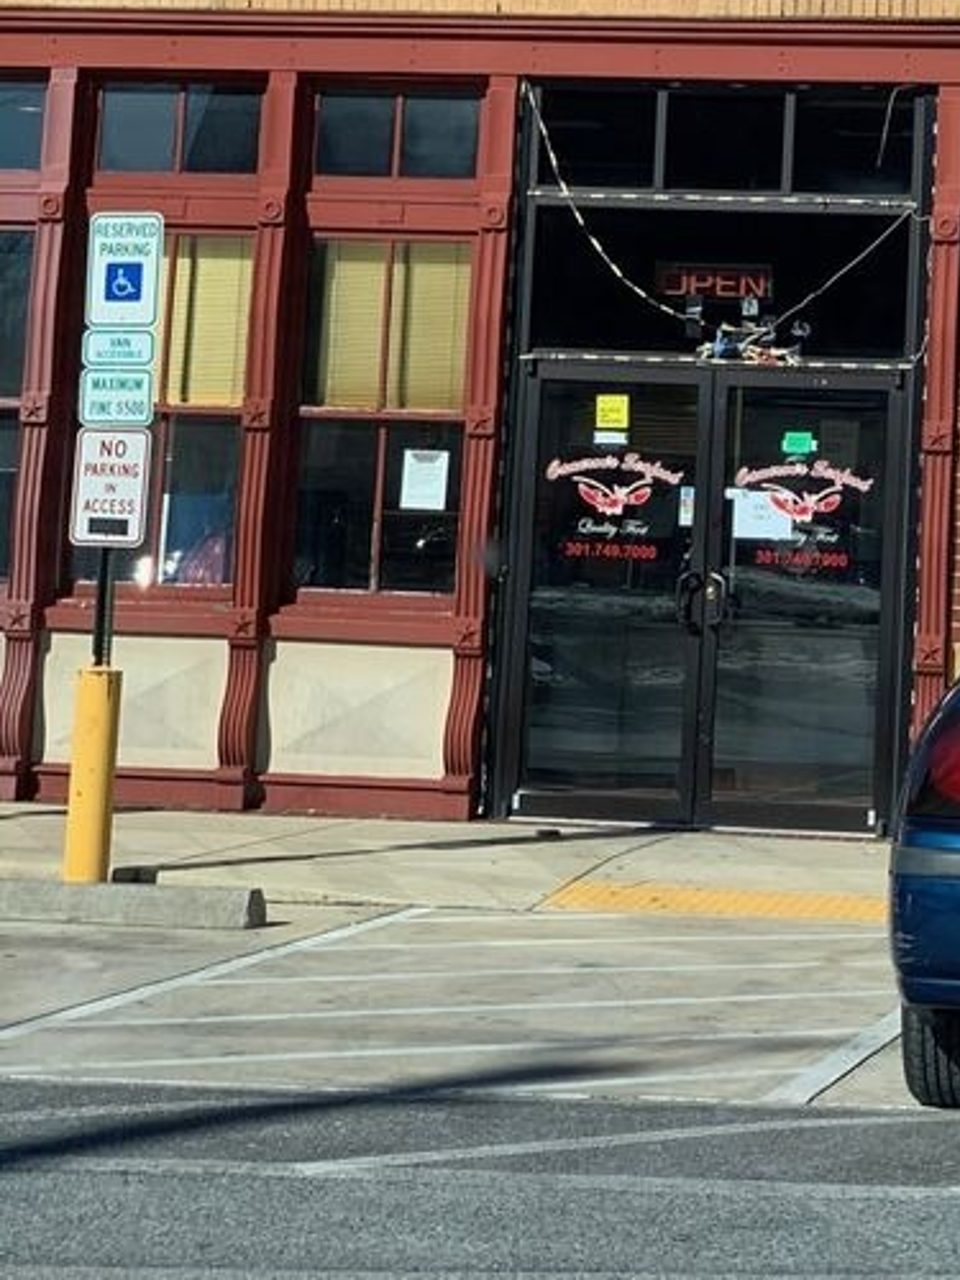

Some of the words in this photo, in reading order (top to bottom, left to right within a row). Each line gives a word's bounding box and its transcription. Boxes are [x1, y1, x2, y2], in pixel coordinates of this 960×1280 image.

[95, 222, 159, 238] RESERVED
[100, 242, 152, 256] PARKING
[91, 378, 144, 390] MAXIMUM
[89, 401, 112, 416] FINE
[100, 439, 127, 458] NO
[84, 462, 140, 479] PARKING
[105, 482, 117, 494] IN
[82, 498, 136, 515] ACCESS
